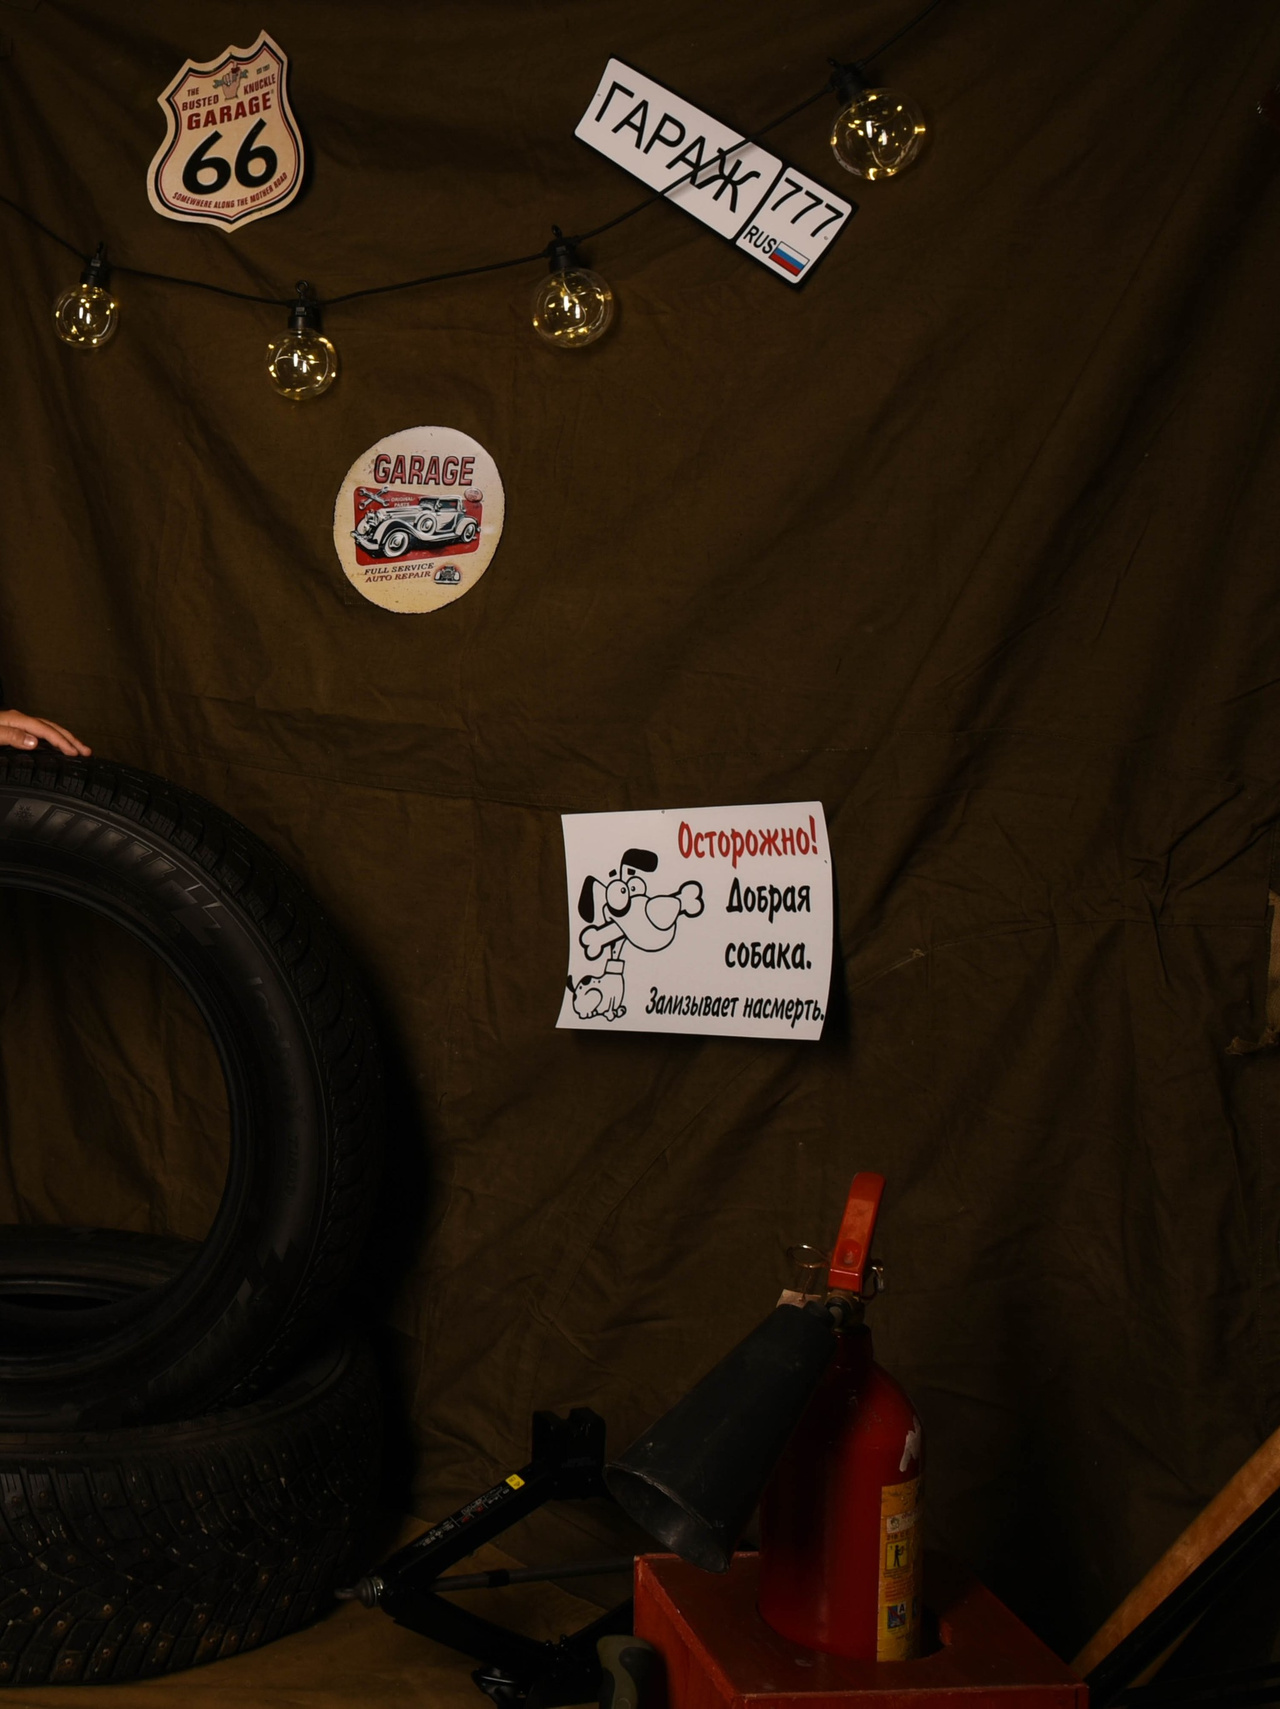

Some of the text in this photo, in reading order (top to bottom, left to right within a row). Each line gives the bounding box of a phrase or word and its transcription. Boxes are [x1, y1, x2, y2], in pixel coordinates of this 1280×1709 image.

[182, 74, 276, 111] BUSTED KNUCKLE
[187, 87, 199, 97] THE
[187, 91, 272, 130] GARAGE
[182, 118, 278, 195] 66
[594, 80, 761, 214] ГАРАЖ
[172, 172, 288, 209] SOMEWHERE ALONG THE MOTHER ROAD
[770, 177, 843, 238] 777
[742, 225, 777, 255] RUS
[373, 453, 476, 486] GARAGE
[364, 562, 435, 575] FULL SERVICE
[365, 571, 431, 583] AUTO REPAIR
[677, 815, 818, 868] Осторожно!
[725, 877, 811, 923] Добрая
[725, 941, 812, 970] собака.
[645, 986, 825, 1028] Зализывает насмерть.
